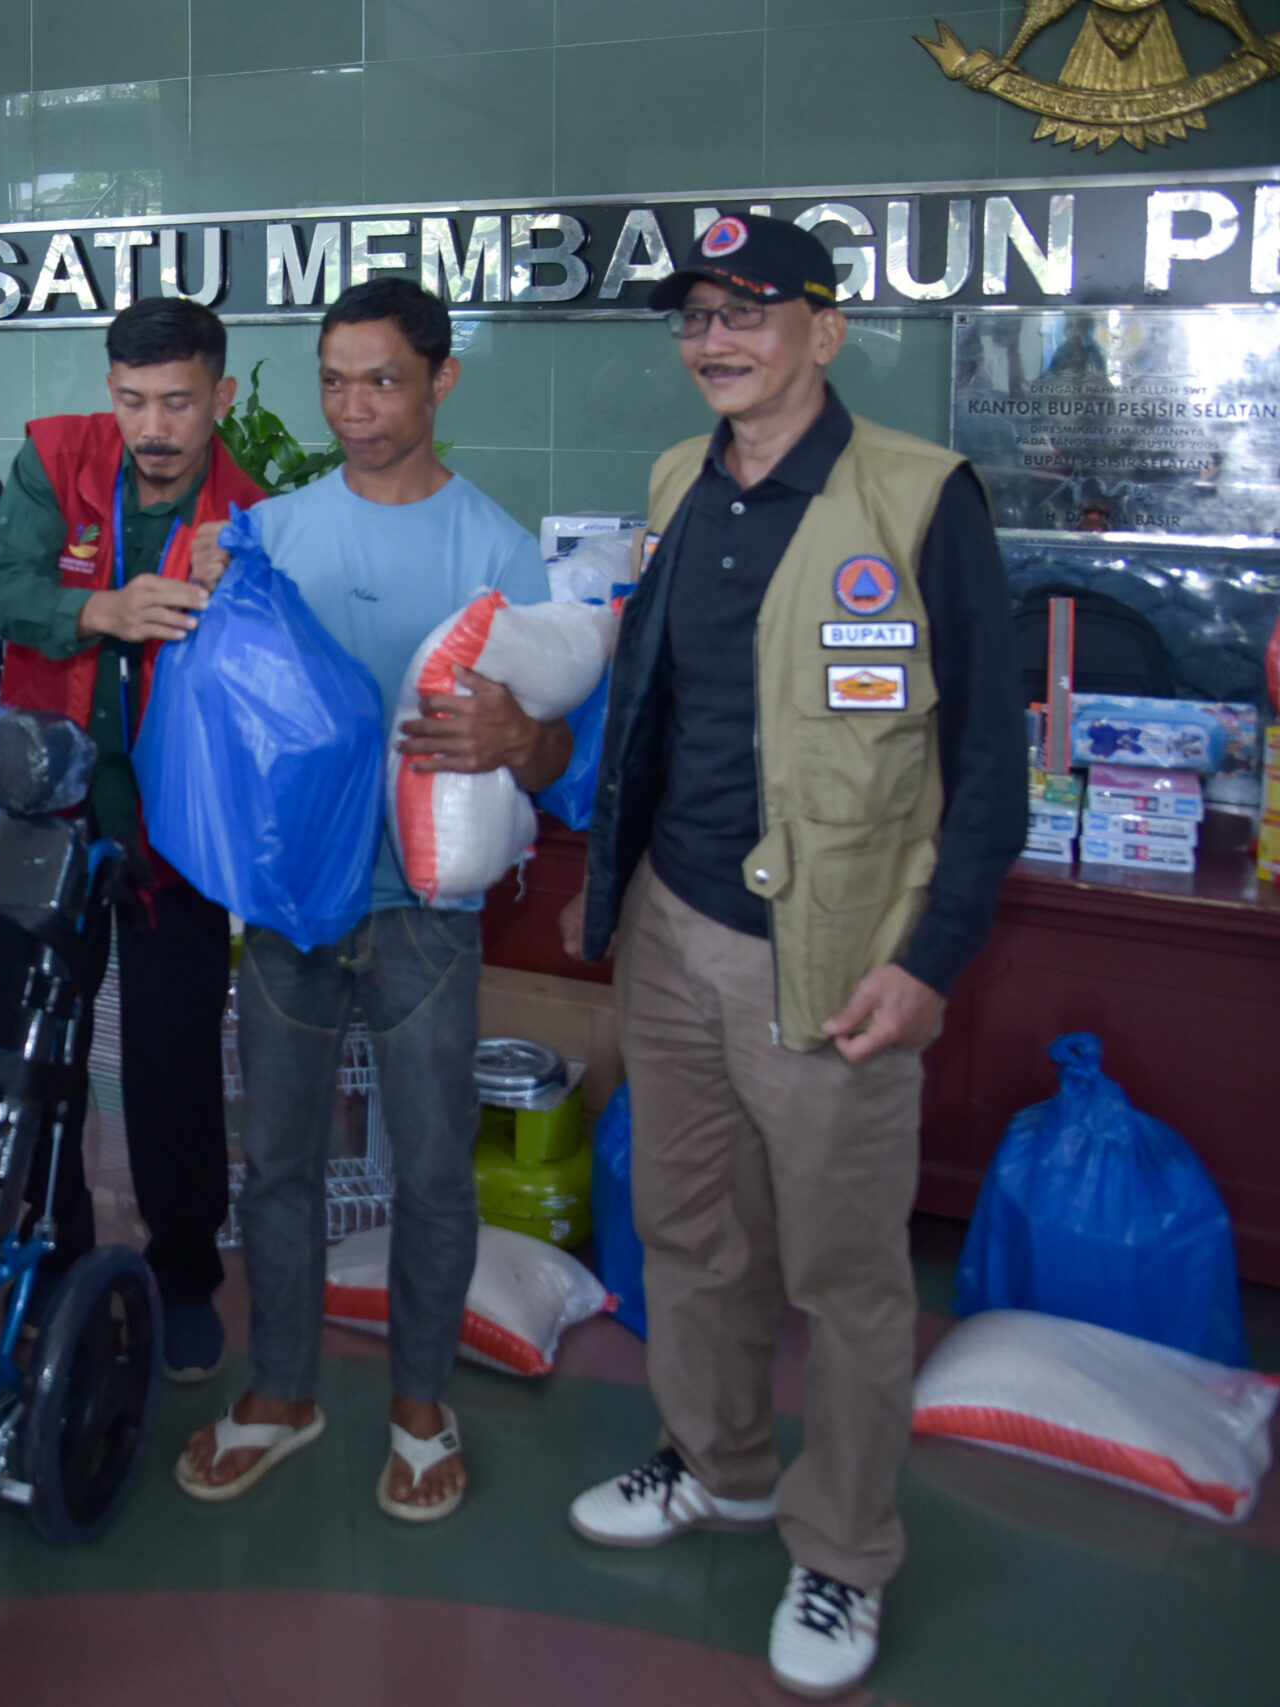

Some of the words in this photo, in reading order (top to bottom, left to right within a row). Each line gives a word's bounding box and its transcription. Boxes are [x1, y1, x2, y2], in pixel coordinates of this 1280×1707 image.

[1031, 385, 1082, 394] DENGAN
[1086, 386, 1137, 395] RAHMAT
[1139, 386, 1179, 396] ALLAH
[1182, 387, 1207, 395] SWT
[968, 401, 1043, 415] KANTOR
[1048, 402, 1111, 416] BUPATI
[1119, 402, 1187, 418] PESISIR
[1193, 403, 1277, 418] SELATAN
[1030, 425, 1103, 434] DIRESMIKAN
[1016, 437, 1047, 446] PADA
[1024, 455, 1076, 466] BUPATI
[1081, 456, 1135, 468] PESISIR
[1142, 459, 1209, 470] SELATAN
[1135, 514, 1180, 527] BASIR
[831, 627, 906, 642] BUPATI
